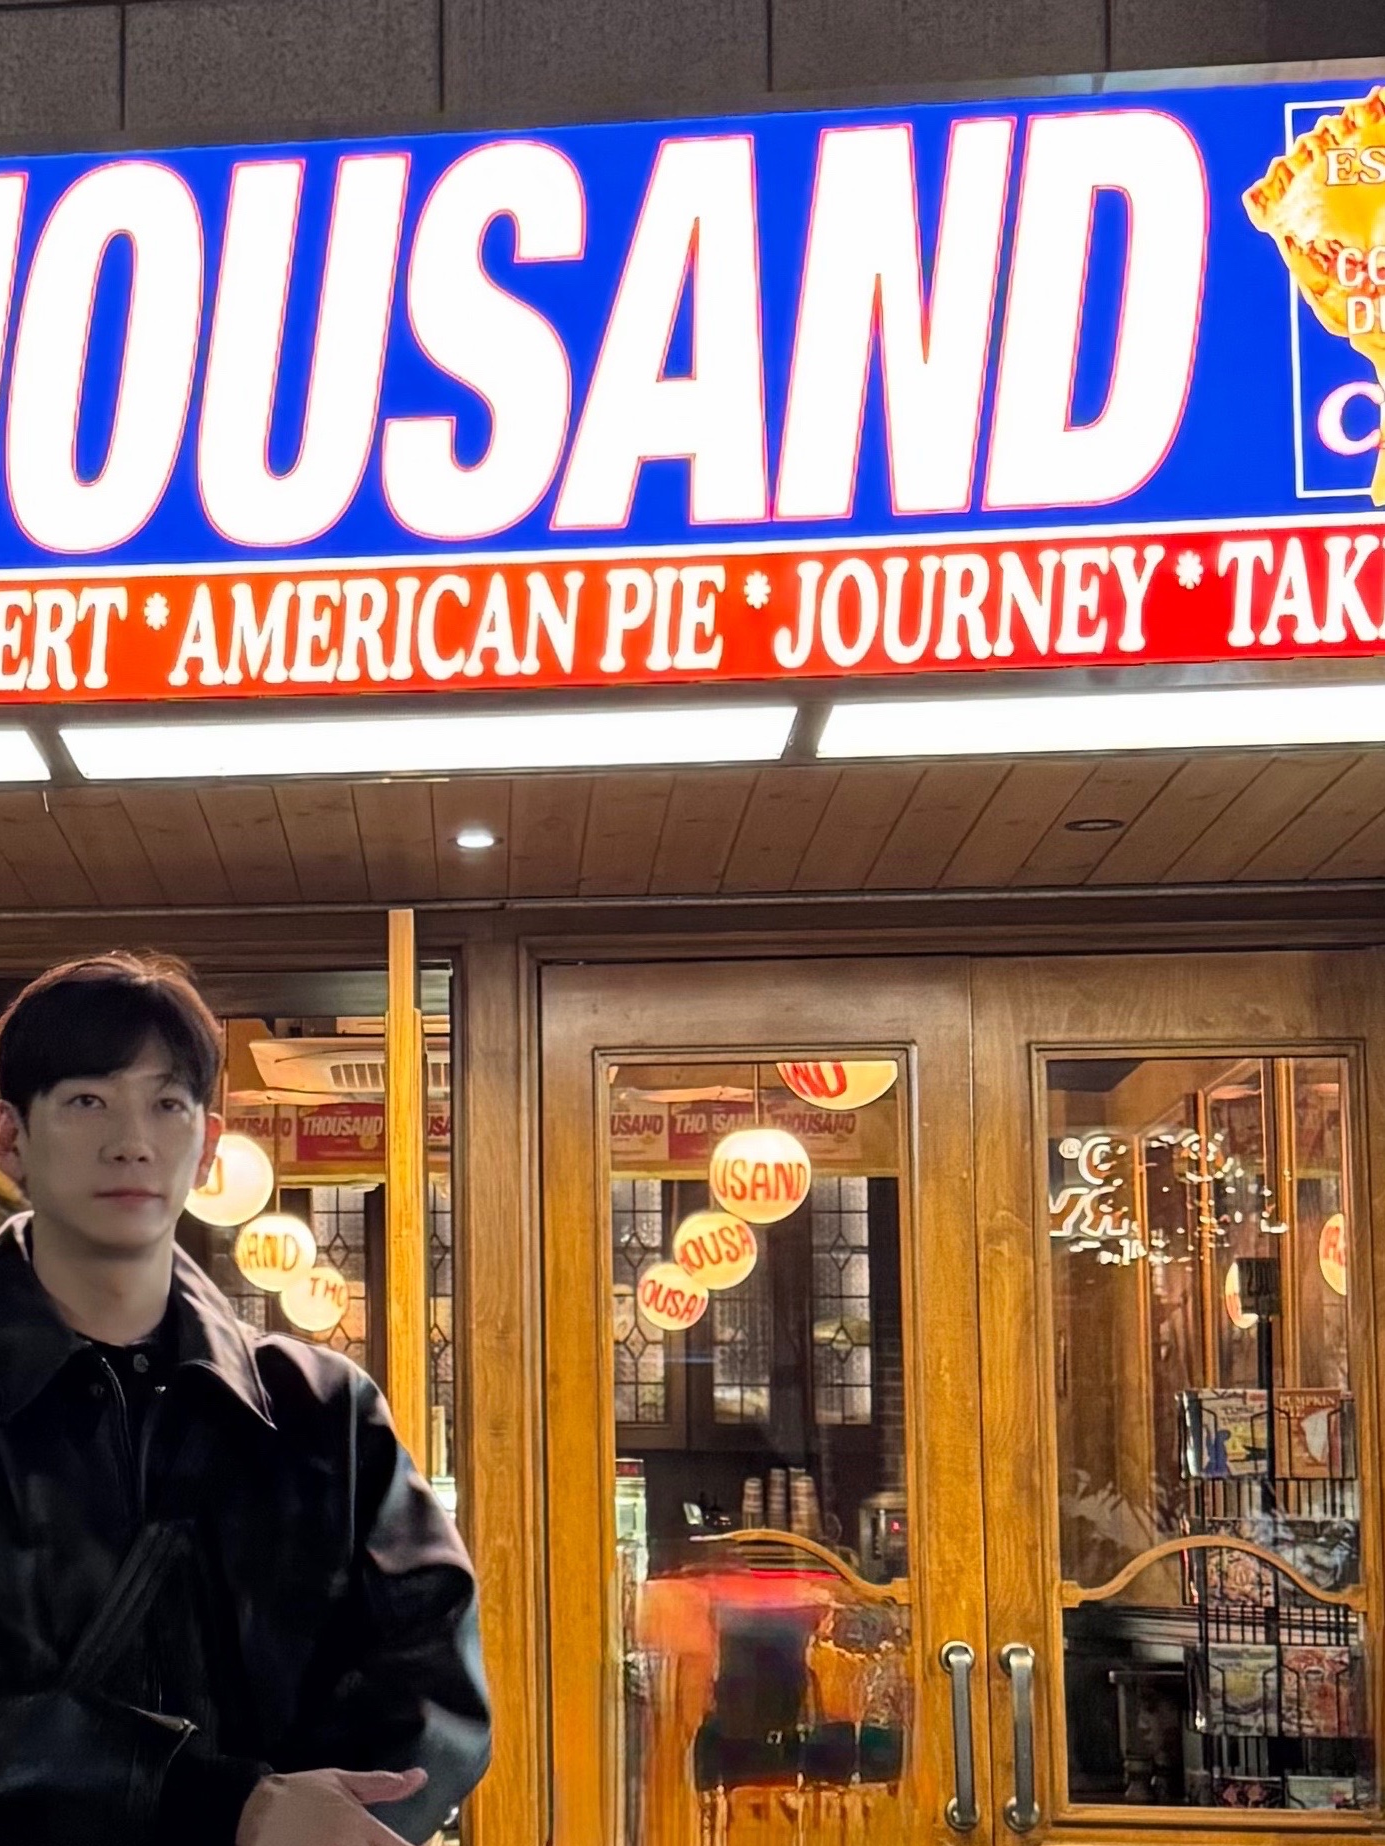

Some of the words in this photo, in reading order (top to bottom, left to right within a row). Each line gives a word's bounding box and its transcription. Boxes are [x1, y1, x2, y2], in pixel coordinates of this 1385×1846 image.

[167, 570, 585, 687] AMERICAN
[599, 563, 727, 673] PIE
[773, 543, 1166, 669] JOURNEY
[1217, 534, 1384, 648] TAK
[302, 1116, 383, 1137] THOUSAND
